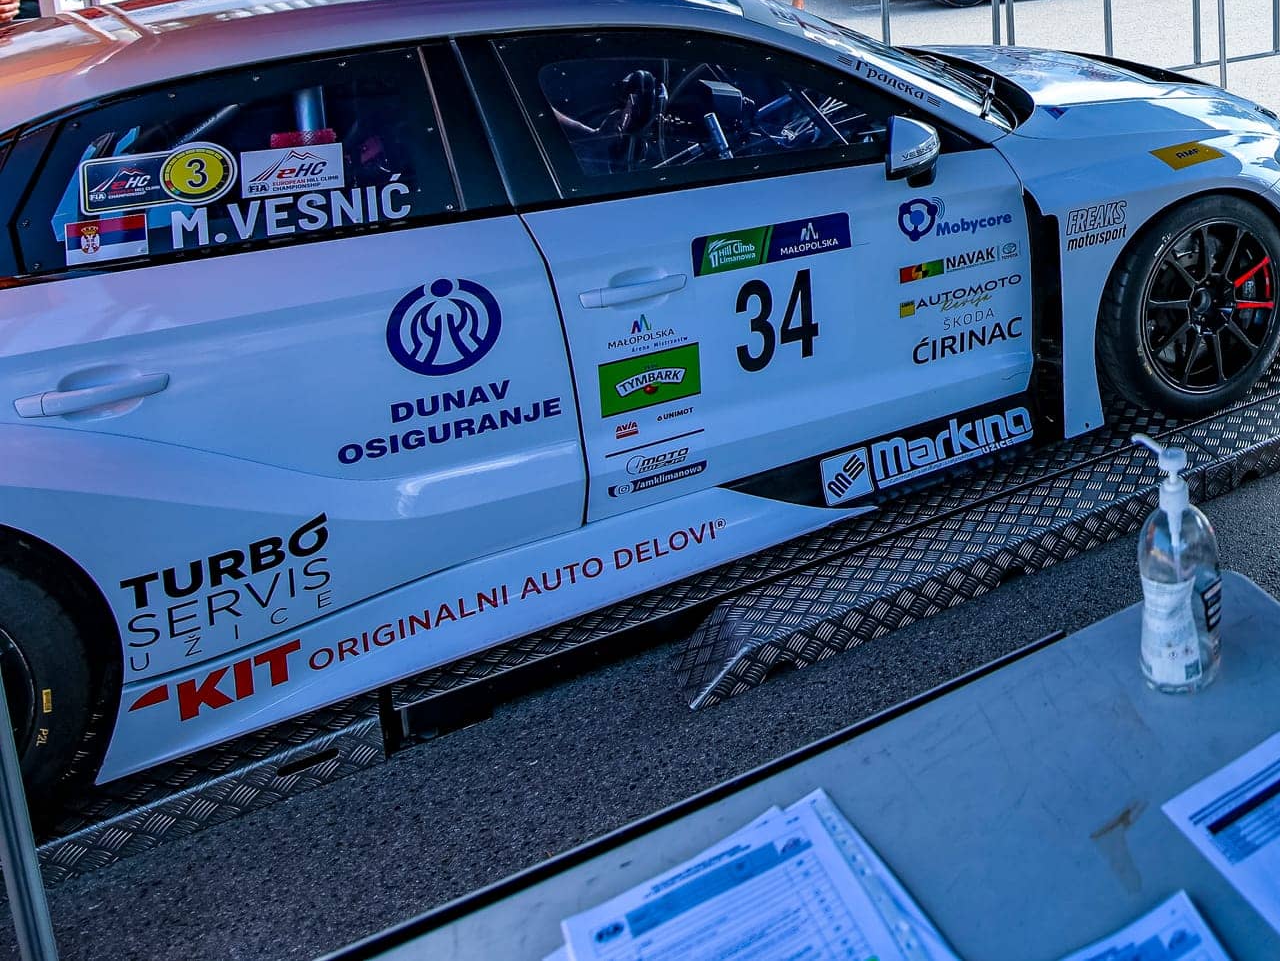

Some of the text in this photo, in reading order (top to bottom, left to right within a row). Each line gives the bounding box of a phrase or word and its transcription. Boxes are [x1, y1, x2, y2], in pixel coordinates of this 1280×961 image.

[855, 60, 925, 101] Градска
[186, 158, 209, 188] 3
[276, 161, 327, 180] eHC
[272, 183, 320, 192] CHAMPIONSHIP
[171, 173, 412, 250] M.VESNIĆ
[935, 211, 1013, 237] Mobycore
[1066, 201, 1127, 236] FREAKS
[718, 242, 756, 257] Hill Climb
[780, 238, 839, 256] MAŁOPOLSKA
[1067, 224, 1127, 252] motorsport
[719, 253, 757, 264] Limanowa
[946, 246, 995, 270] NAVAK
[916, 274, 1022, 310] AUTOMOTO
[735, 268, 820, 373] 34
[943, 307, 995, 331] ŠKODA
[607, 328, 675, 350] MAŁOPOLSKA
[912, 316, 1023, 365] ĆIRINAC
[619, 369, 681, 393] TYMBARK
[390, 380, 511, 424] DUNAV
[663, 407, 695, 420] UNIMOT
[337, 397, 562, 465] OSIGURANJE
[119, 513, 329, 611] TURBO
[127, 556, 331, 648] SERVIS
[308, 584, 511, 671] ORIGINALNI
[519, 555, 604, 602] AUTO
[176, 639, 302, 723] KIT
